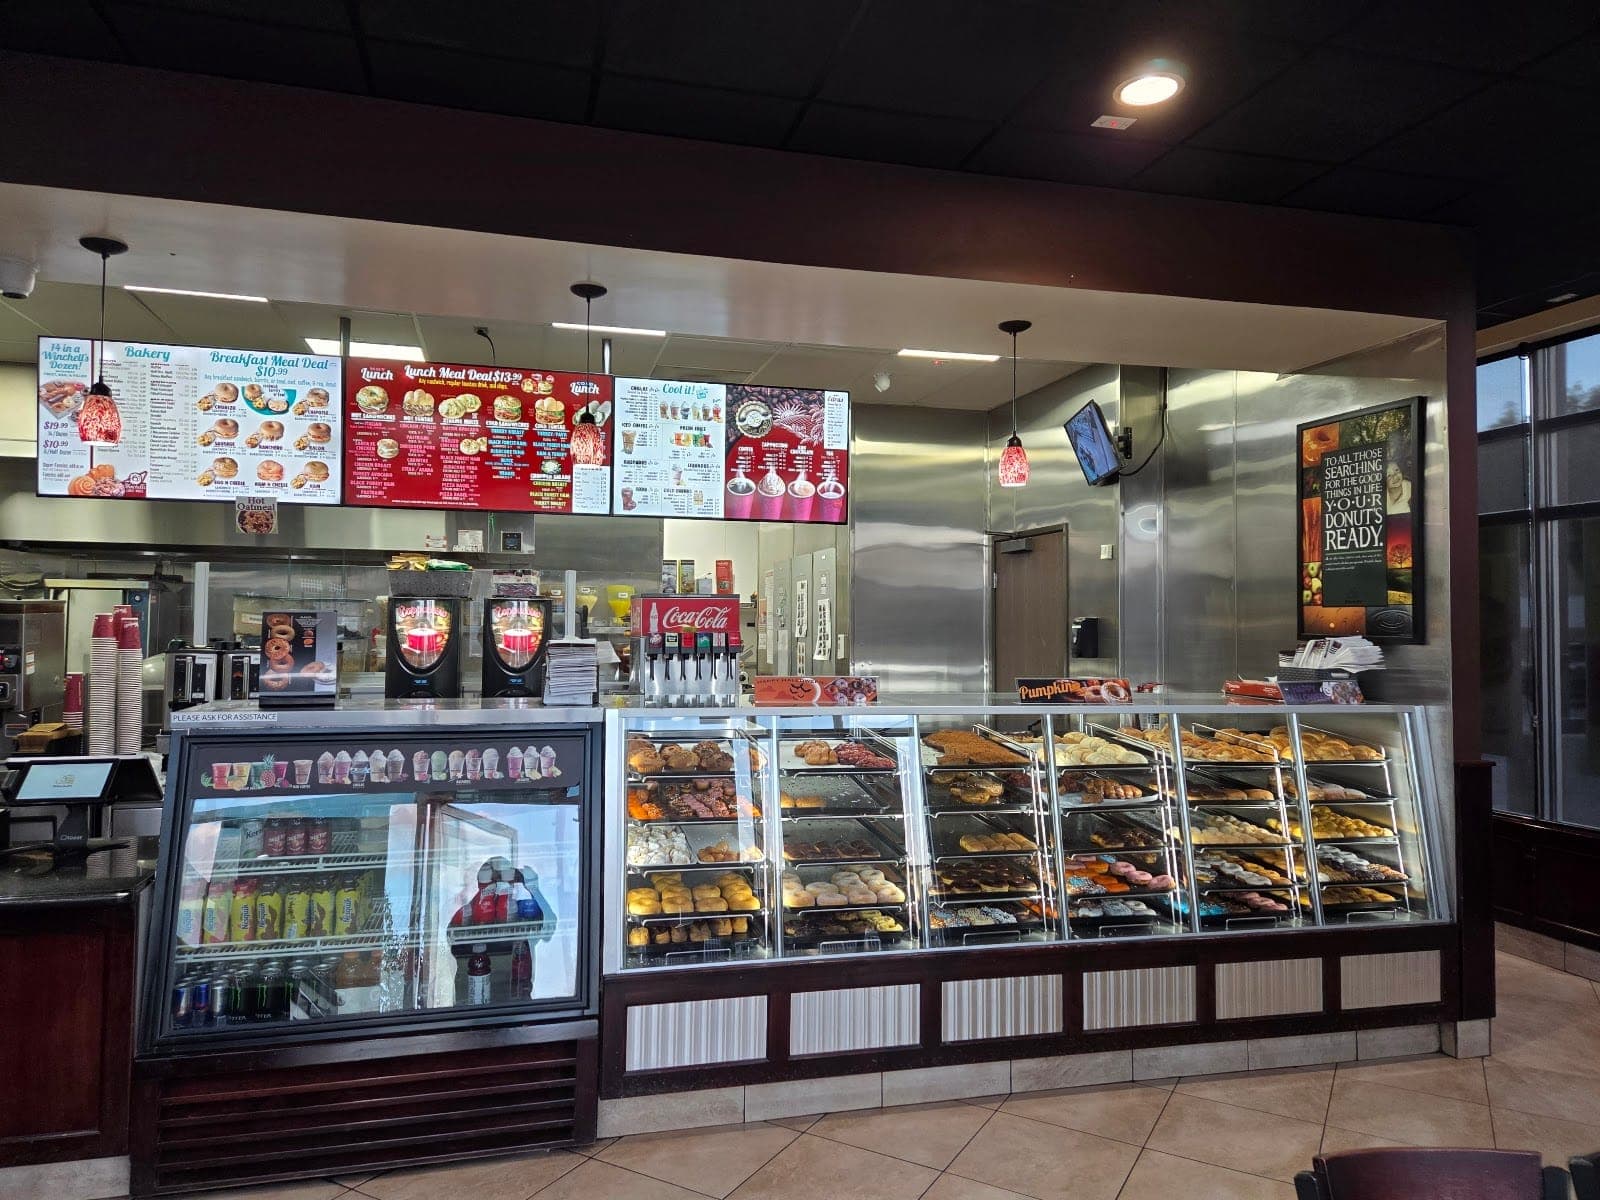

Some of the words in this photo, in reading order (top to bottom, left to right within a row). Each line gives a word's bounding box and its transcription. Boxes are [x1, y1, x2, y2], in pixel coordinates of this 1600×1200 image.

[51, 344, 61, 352] 14
[62, 344, 72, 352] in
[124, 346, 171, 362] Bakery
[42, 351, 89, 362] Winchell's
[210, 350, 268, 367] Breakfast
[270, 355, 299, 368] Meal
[302, 358, 328, 370] Deal
[49, 360, 82, 370] Dozen!
[255, 366, 288, 378] $10.99
[361, 368, 394, 382] Lunch
[404, 364, 436, 380] Lunch
[439, 367, 465, 379] Meal
[467, 370, 492, 381] Deal
[493, 370, 522, 384] $13.99
[570, 382, 600, 396] Lunch
[663, 384, 684, 394] Cool
[685, 384, 696, 395] it!
[44, 421, 68, 430] $19.99
[43, 440, 68, 448] $10.99
[1326, 456, 1336, 467] TO
[1338, 454, 1352, 464] ALL
[1353, 448, 1382, 462] THOSE
[1325, 458, 1382, 480] SEARCHING
[1325, 478, 1340, 490] FOR
[1342, 476, 1358, 486] THE
[1358, 473, 1382, 485] GOOD
[1326, 487, 1352, 500] THINGS
[1353, 485, 1362, 495] IN
[1325, 507, 1383, 529] DONUT'S
[1325, 525, 1384, 551] READY.
[662, 606, 732, 629] Coca-Cola
[1019, 678, 1073, 700] Pumpkin
[241, 904, 250, 929] Nesquik
